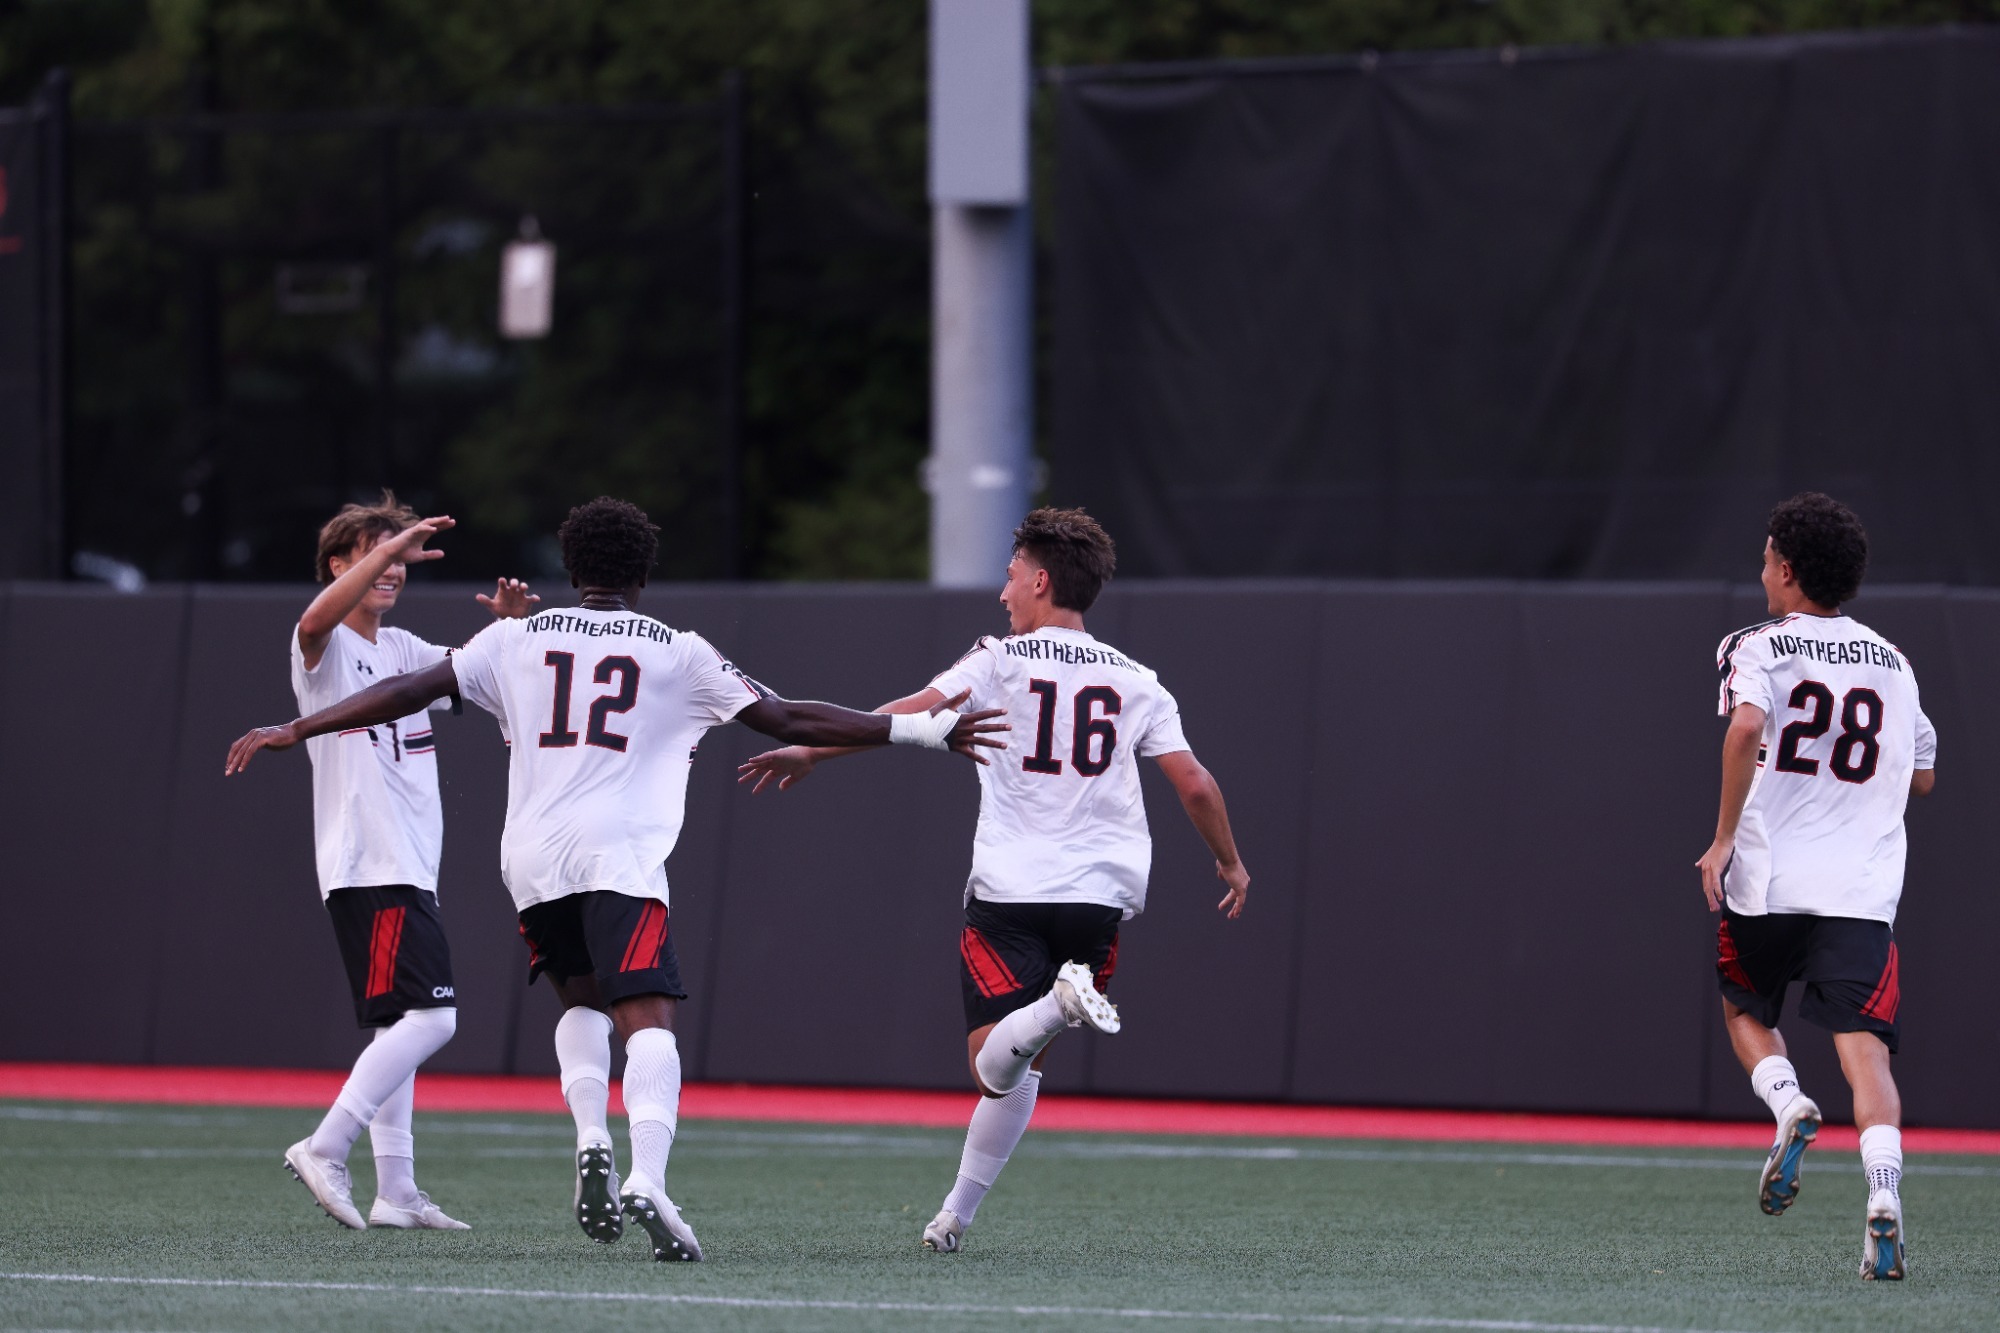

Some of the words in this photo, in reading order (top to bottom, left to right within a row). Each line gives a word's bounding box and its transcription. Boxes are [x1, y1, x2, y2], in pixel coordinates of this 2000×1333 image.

[526, 614, 673, 644] NORTHEASTERN
[1769, 635, 1902, 672] NORTHEASTERN
[538, 650, 641, 752] 12
[1022, 678, 1122, 777] 16
[1775, 679, 1884, 784] 28
